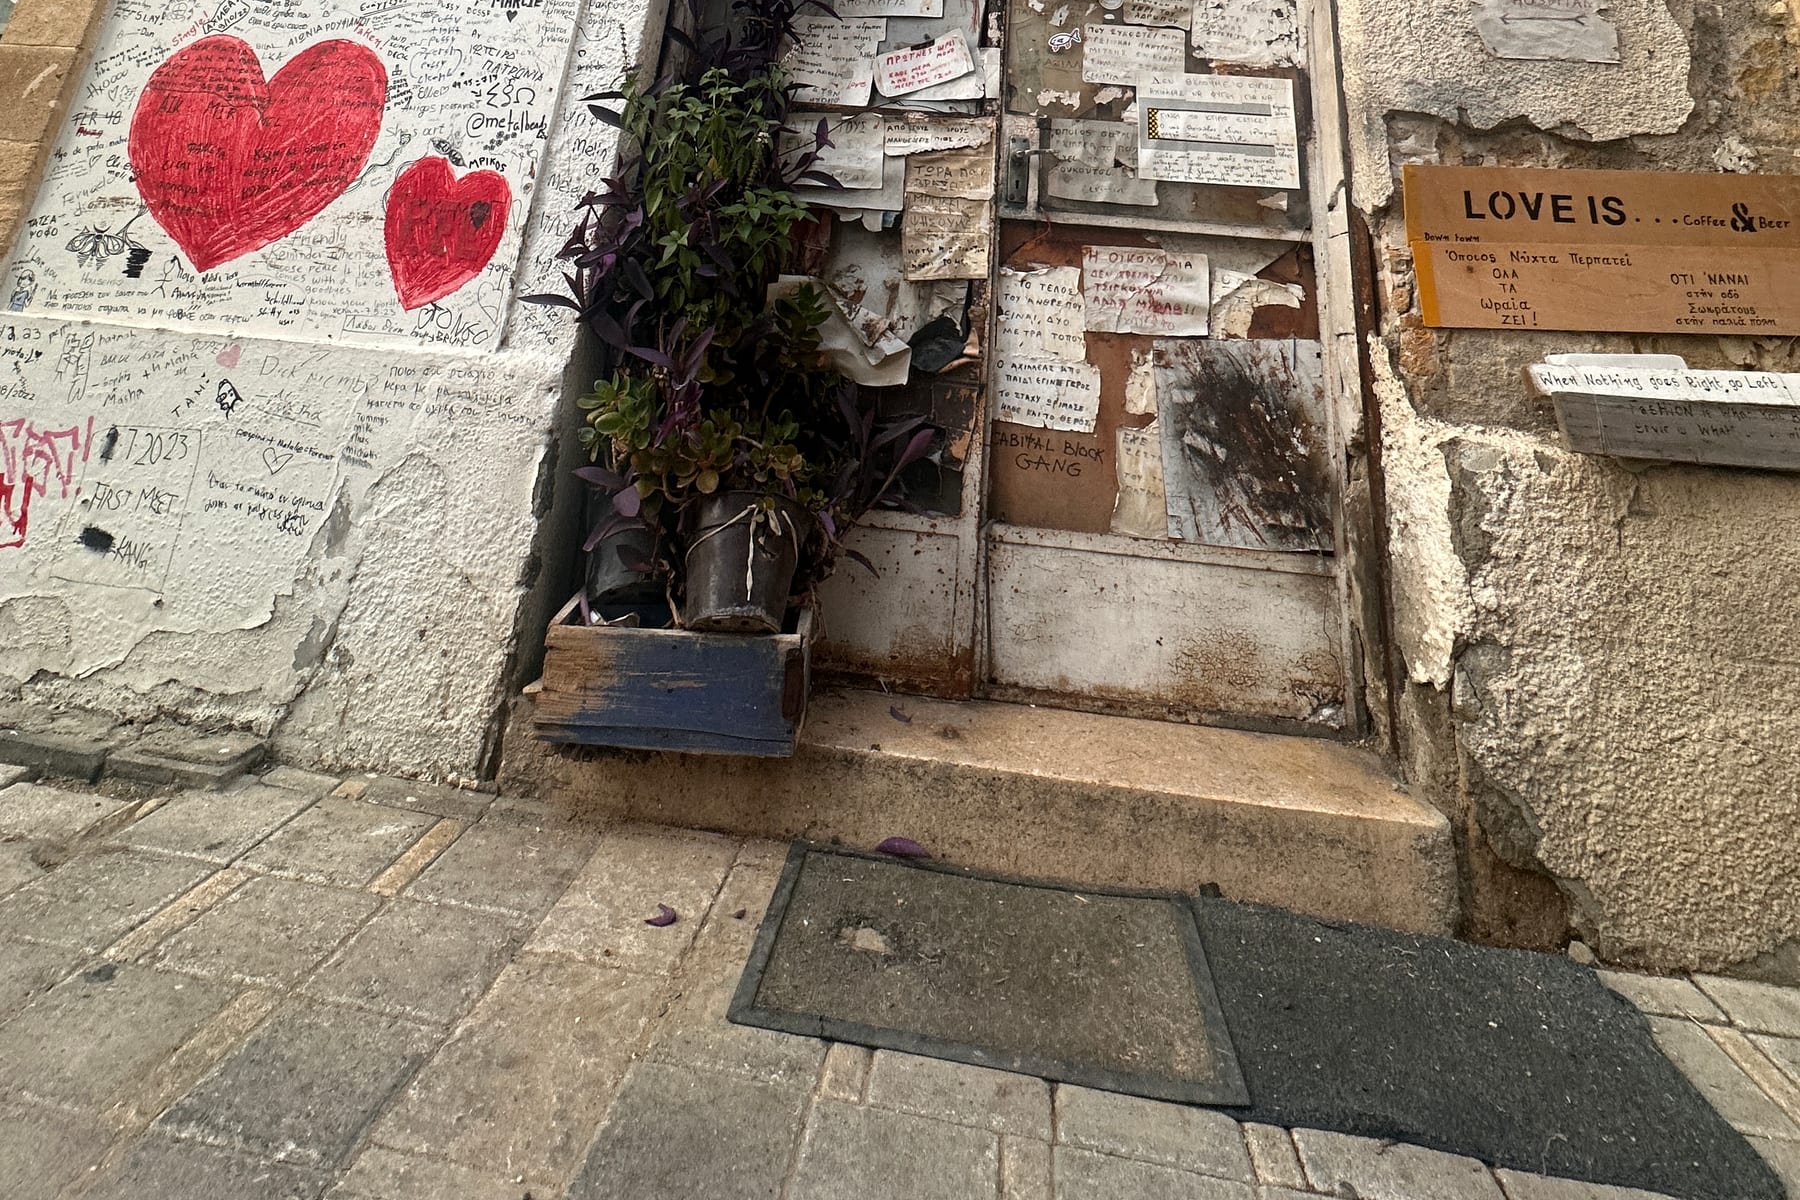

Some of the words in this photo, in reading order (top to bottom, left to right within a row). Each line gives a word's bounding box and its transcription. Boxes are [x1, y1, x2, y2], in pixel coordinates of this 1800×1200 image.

[1463, 190, 1576, 224] LOVE
[1683, 215, 1726, 227] Coffee
[1730, 202, 1757, 232] &
[1758, 216, 1791, 229] Beer
[1584, 374, 1641, 390] Nothing
[1750, 376, 1777, 389] Left
[1015, 453, 1081, 476] GANG
